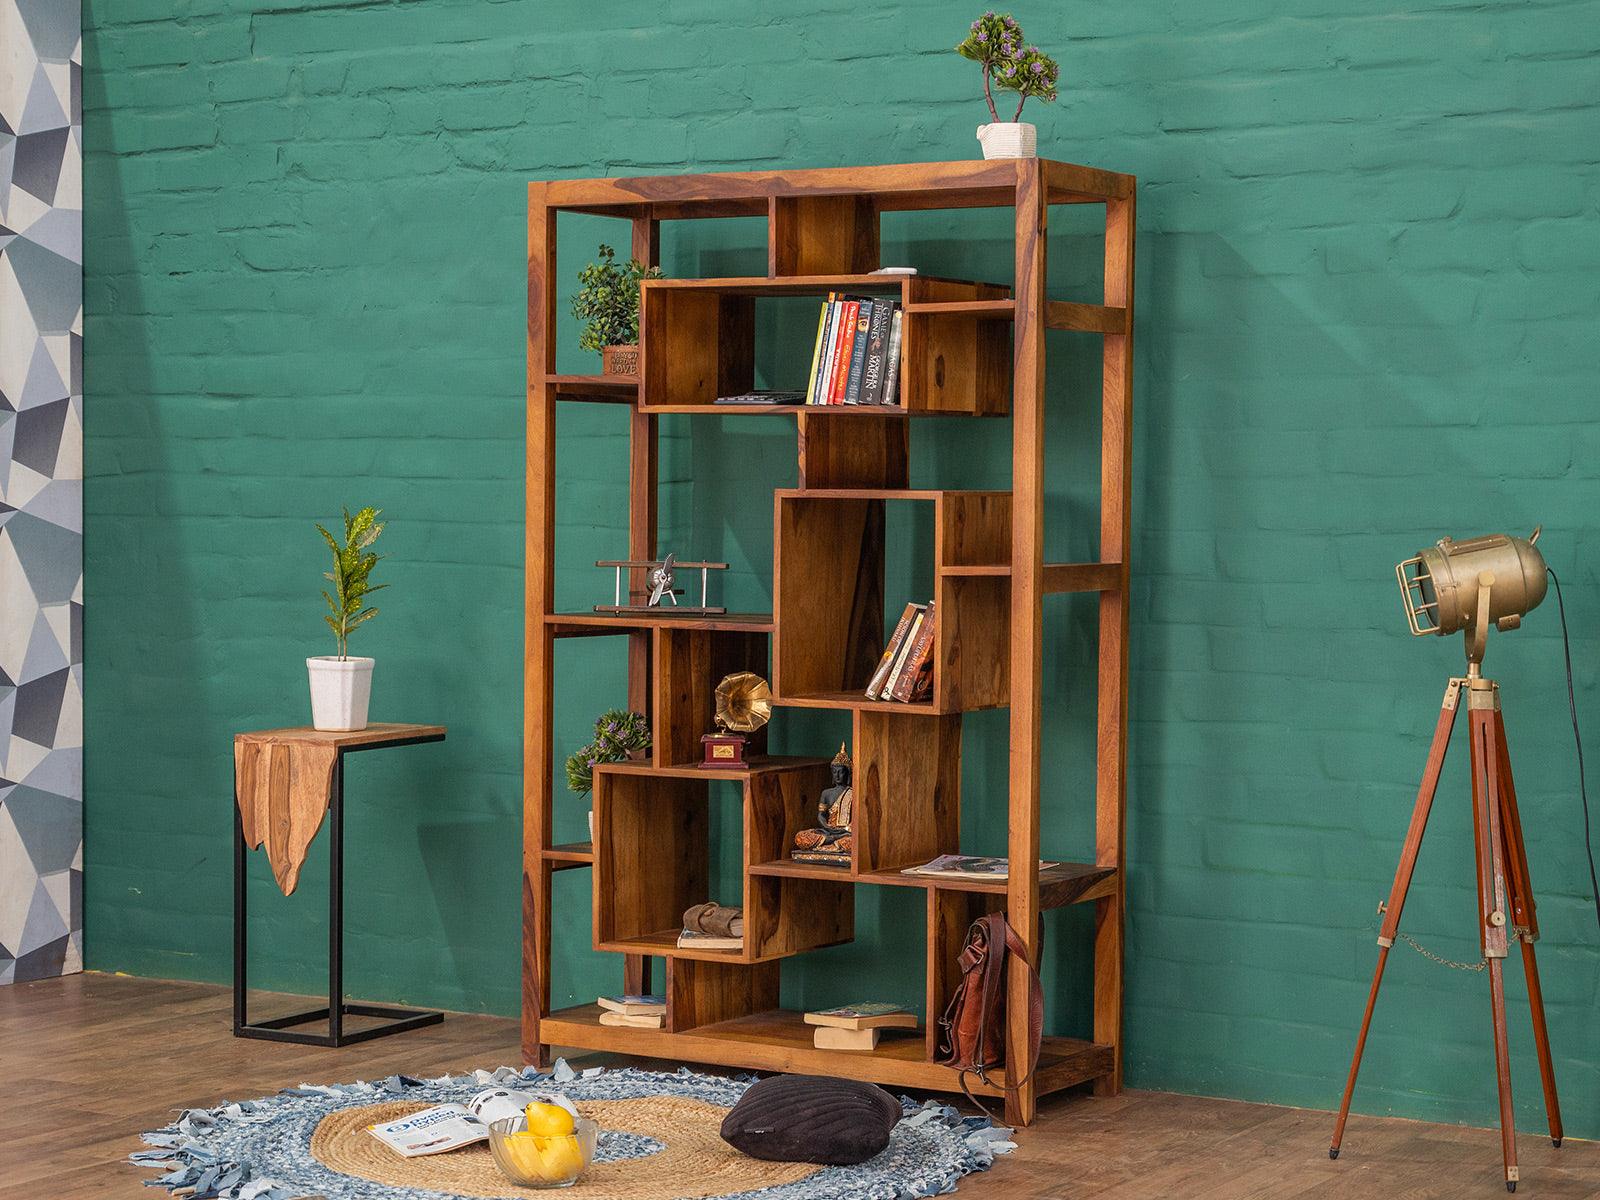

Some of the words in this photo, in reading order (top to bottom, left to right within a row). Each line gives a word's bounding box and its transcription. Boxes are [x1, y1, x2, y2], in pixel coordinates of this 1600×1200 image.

[870, 303, 883, 340] THRONES
[611, 365, 636, 375] LOVE
[864, 354, 877, 389] MARTIN
